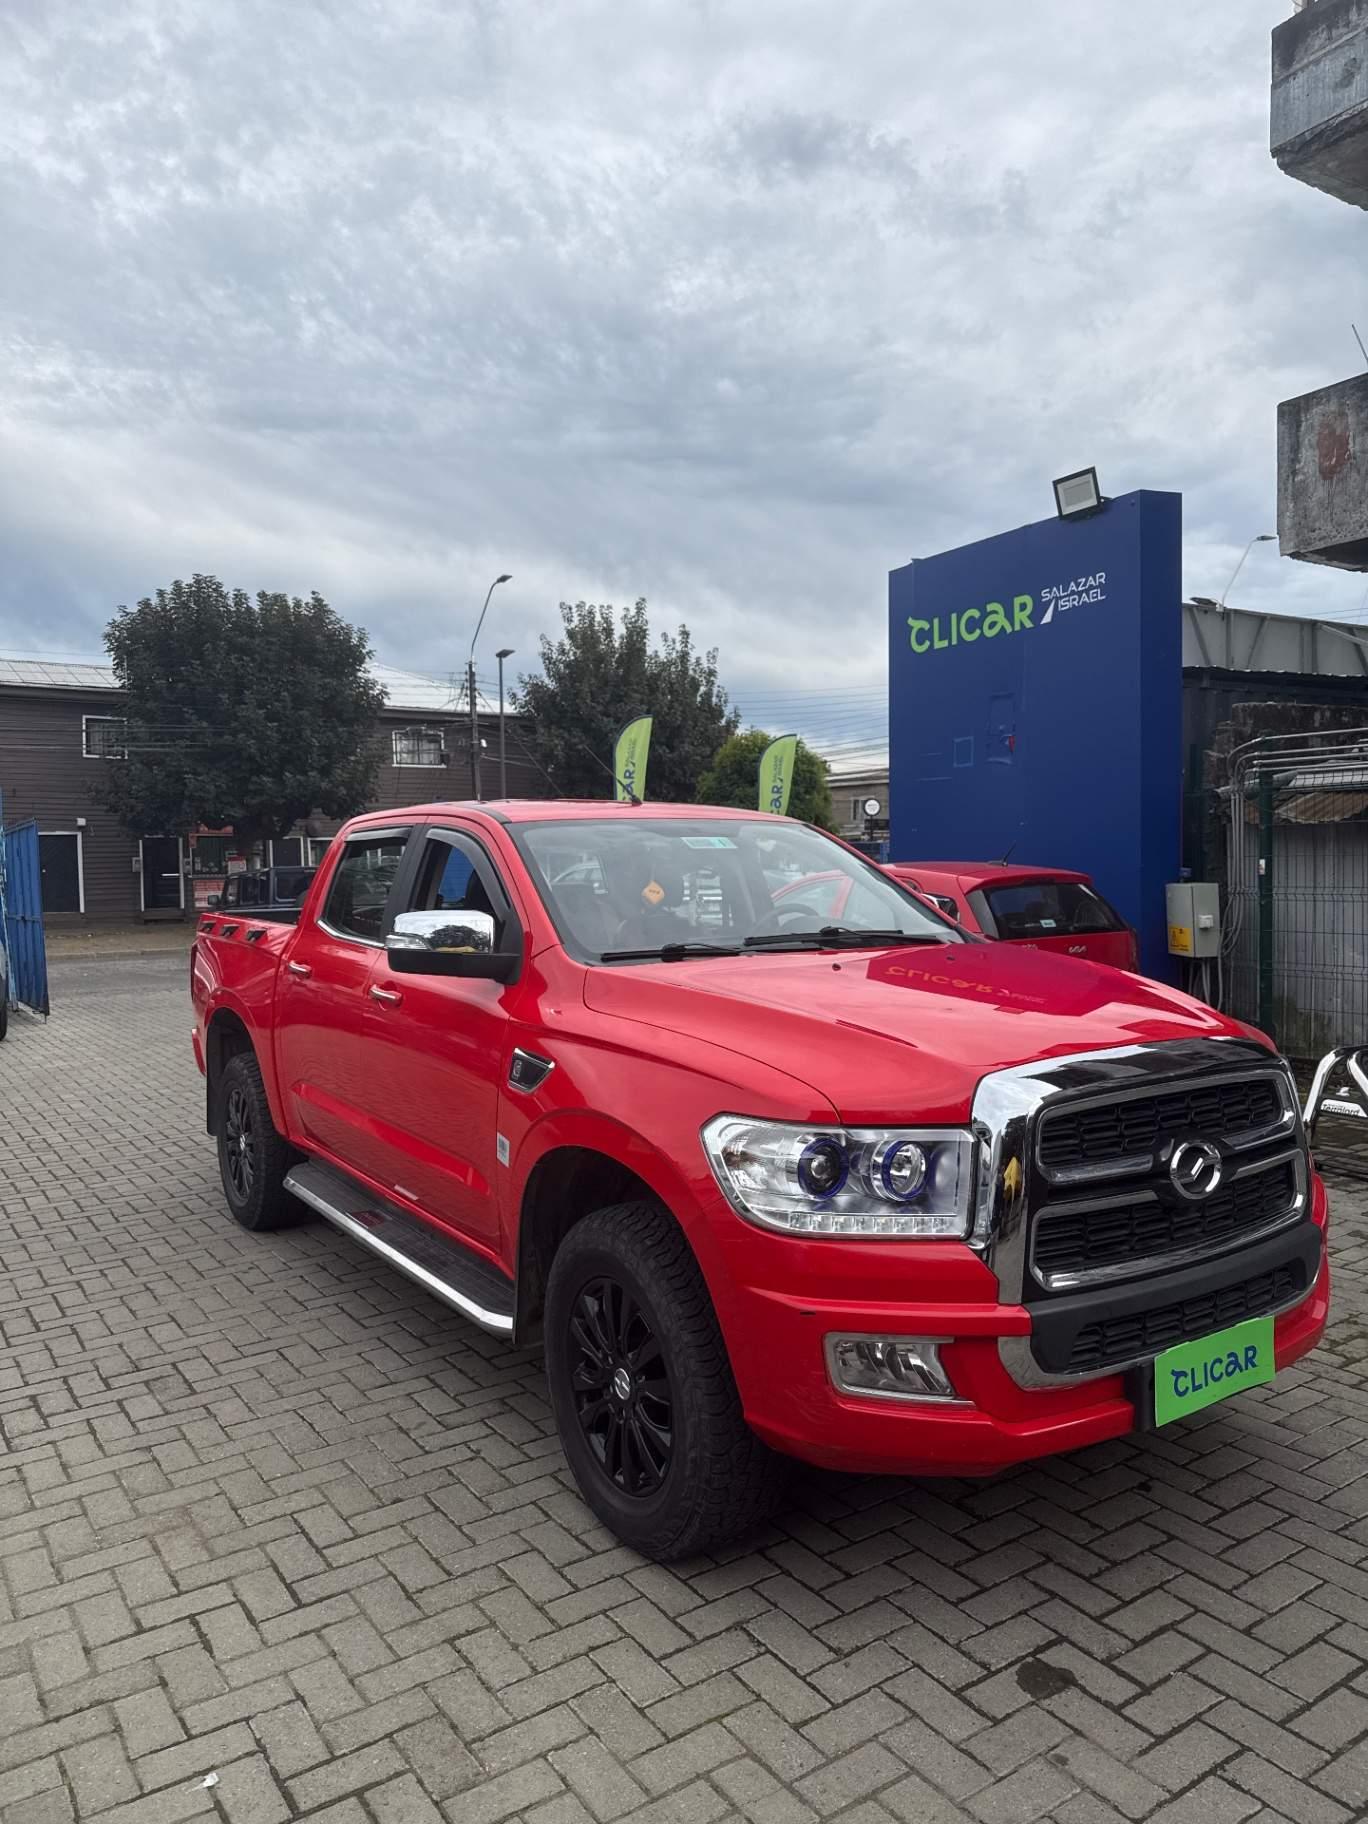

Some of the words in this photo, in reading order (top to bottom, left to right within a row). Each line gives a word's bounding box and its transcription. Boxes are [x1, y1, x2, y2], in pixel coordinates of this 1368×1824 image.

[1041, 572, 1106, 602] SALAZAR
[1058, 588, 1106, 612] ISRAEL
[907, 594, 1035, 654] CLICAR
[1170, 1345, 1259, 1397] CLICAR
